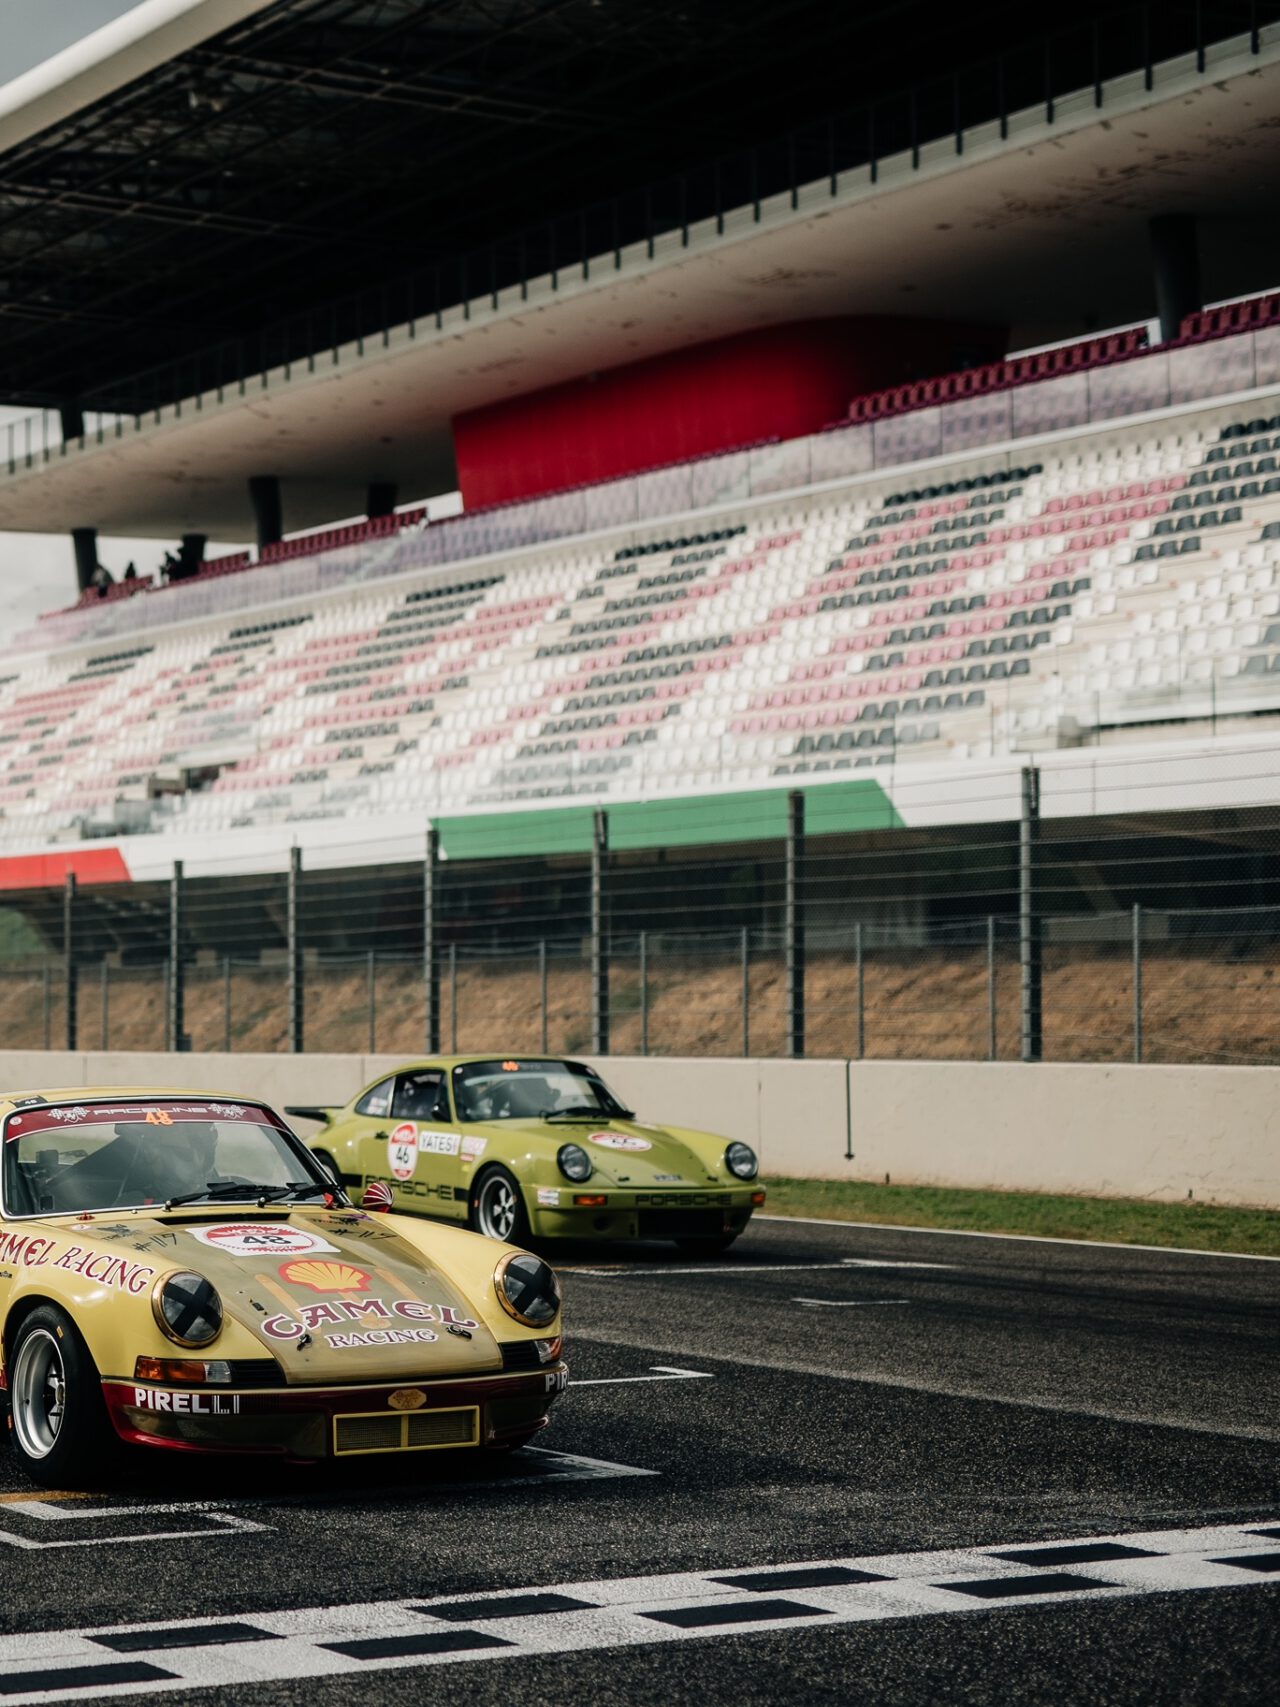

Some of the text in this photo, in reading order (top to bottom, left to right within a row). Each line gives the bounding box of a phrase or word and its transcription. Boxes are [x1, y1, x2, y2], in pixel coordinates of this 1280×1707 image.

[93, 1106, 208, 1116] RACELINE
[145, 1111, 174, 1127] 48
[422, 1133, 453, 1152] YATES
[396, 1146, 409, 1164] 46
[636, 1194, 732, 1206] PORSCHE
[243, 1235, 292, 1245] 48
[52, 1246, 155, 1294] RACING
[261, 1298, 480, 1340] CAMEL
[325, 1328, 438, 1349] RACING
[134, 1387, 240, 1415] PIRELLI
